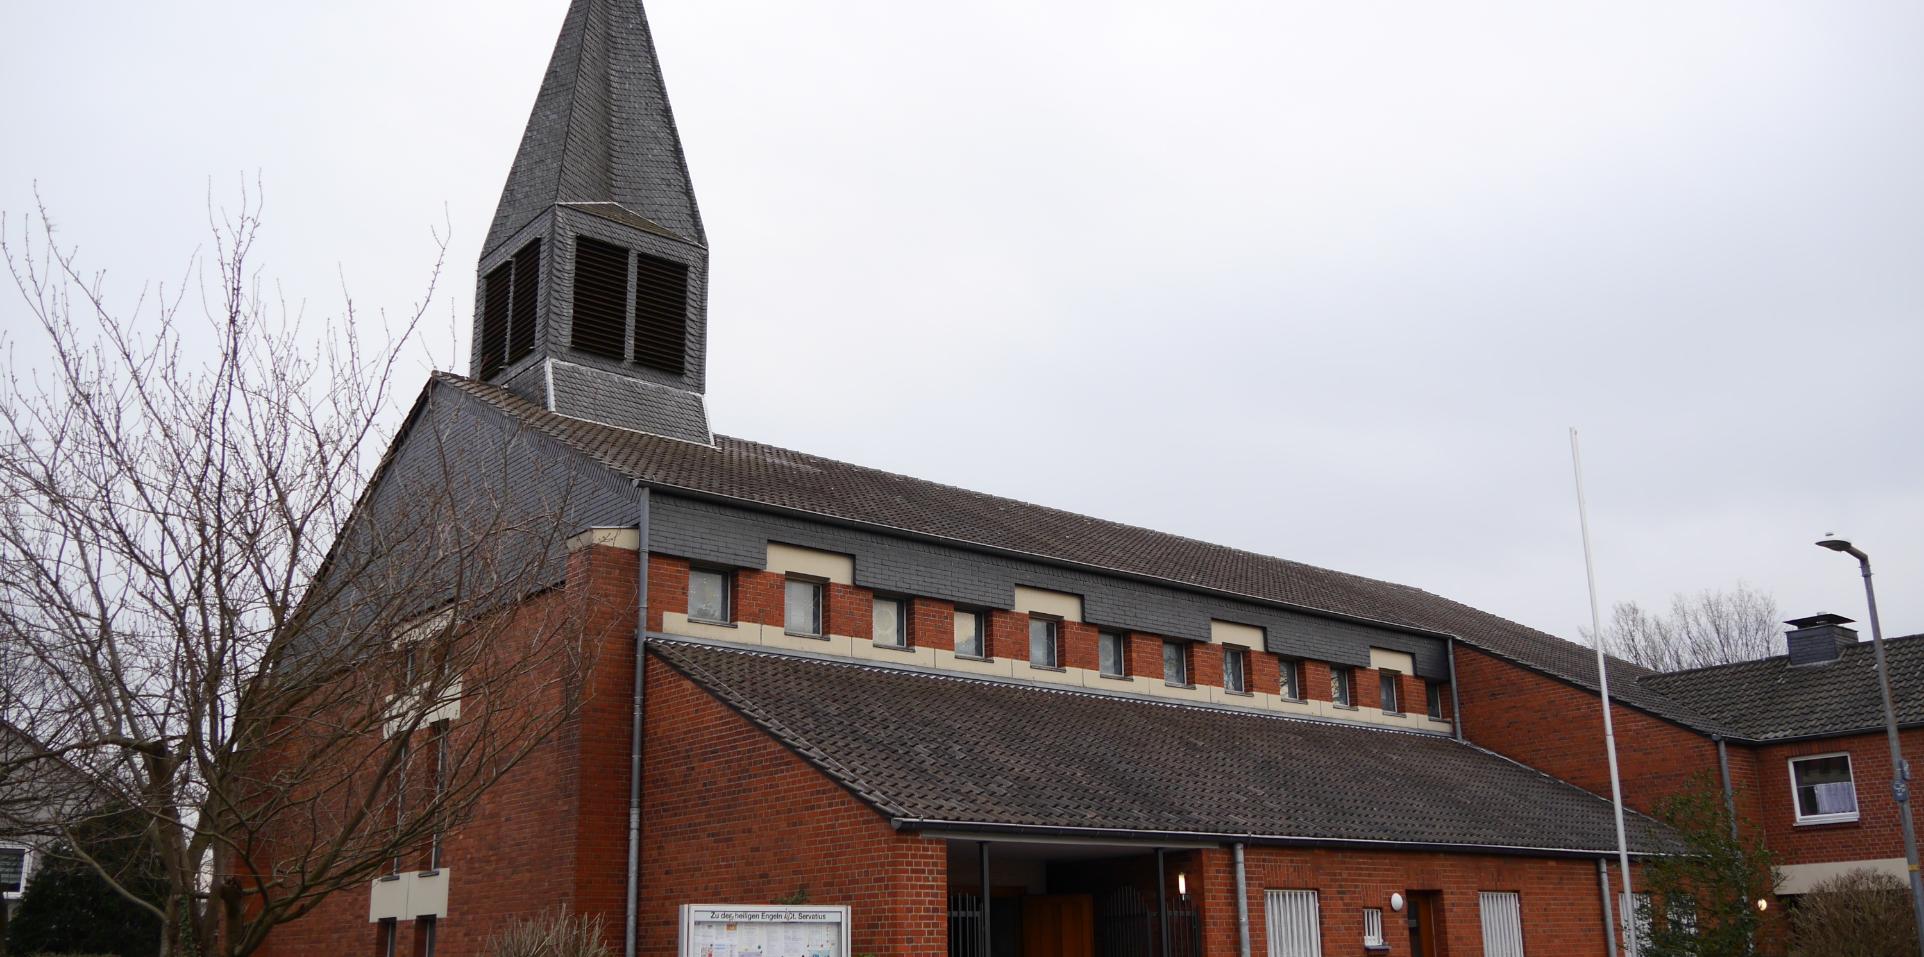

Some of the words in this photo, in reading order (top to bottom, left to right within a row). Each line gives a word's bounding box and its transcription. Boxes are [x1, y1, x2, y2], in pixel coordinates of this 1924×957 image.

[710, 911, 720, 919] Zu
[735, 912, 760, 921] heiligen
[761, 912, 783, 921] Engeln
[798, 912, 826, 920] Servatius
